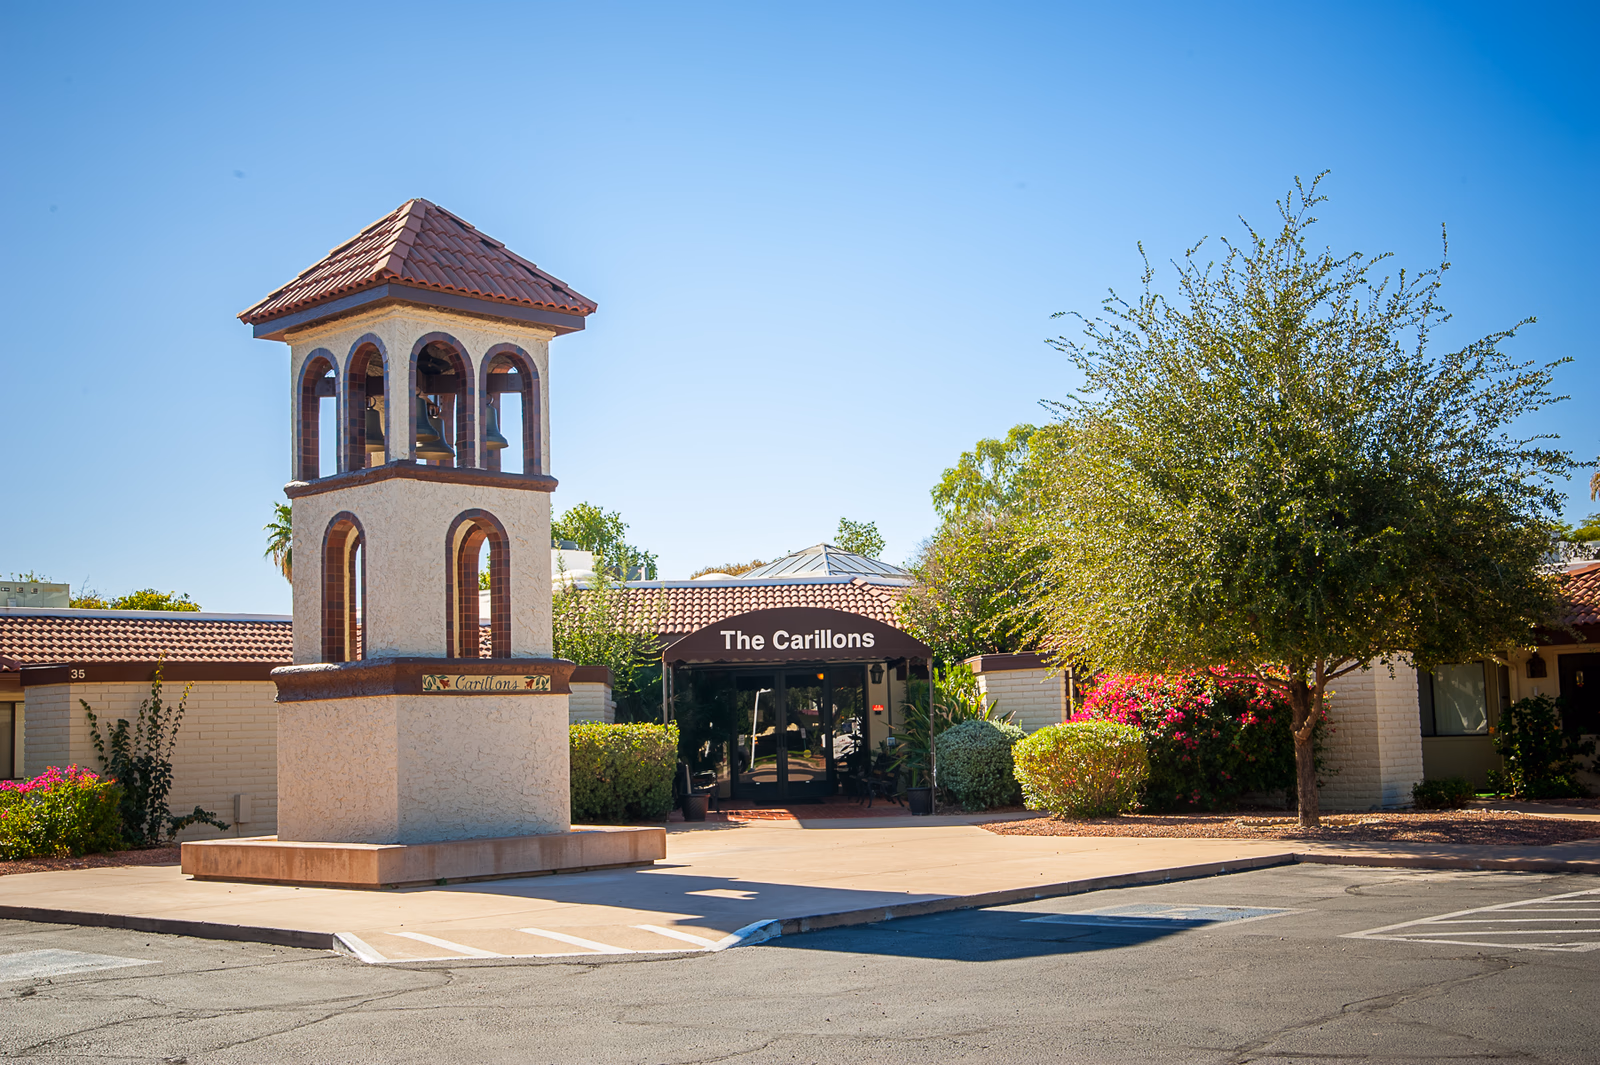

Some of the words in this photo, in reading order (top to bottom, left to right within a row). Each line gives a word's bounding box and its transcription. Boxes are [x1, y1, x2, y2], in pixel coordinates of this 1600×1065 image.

[720, 630, 765, 650] The
[772, 630, 875, 650] Carillons
[71, 669, 85, 679] 35
[455, 675, 520, 690] Carillons
